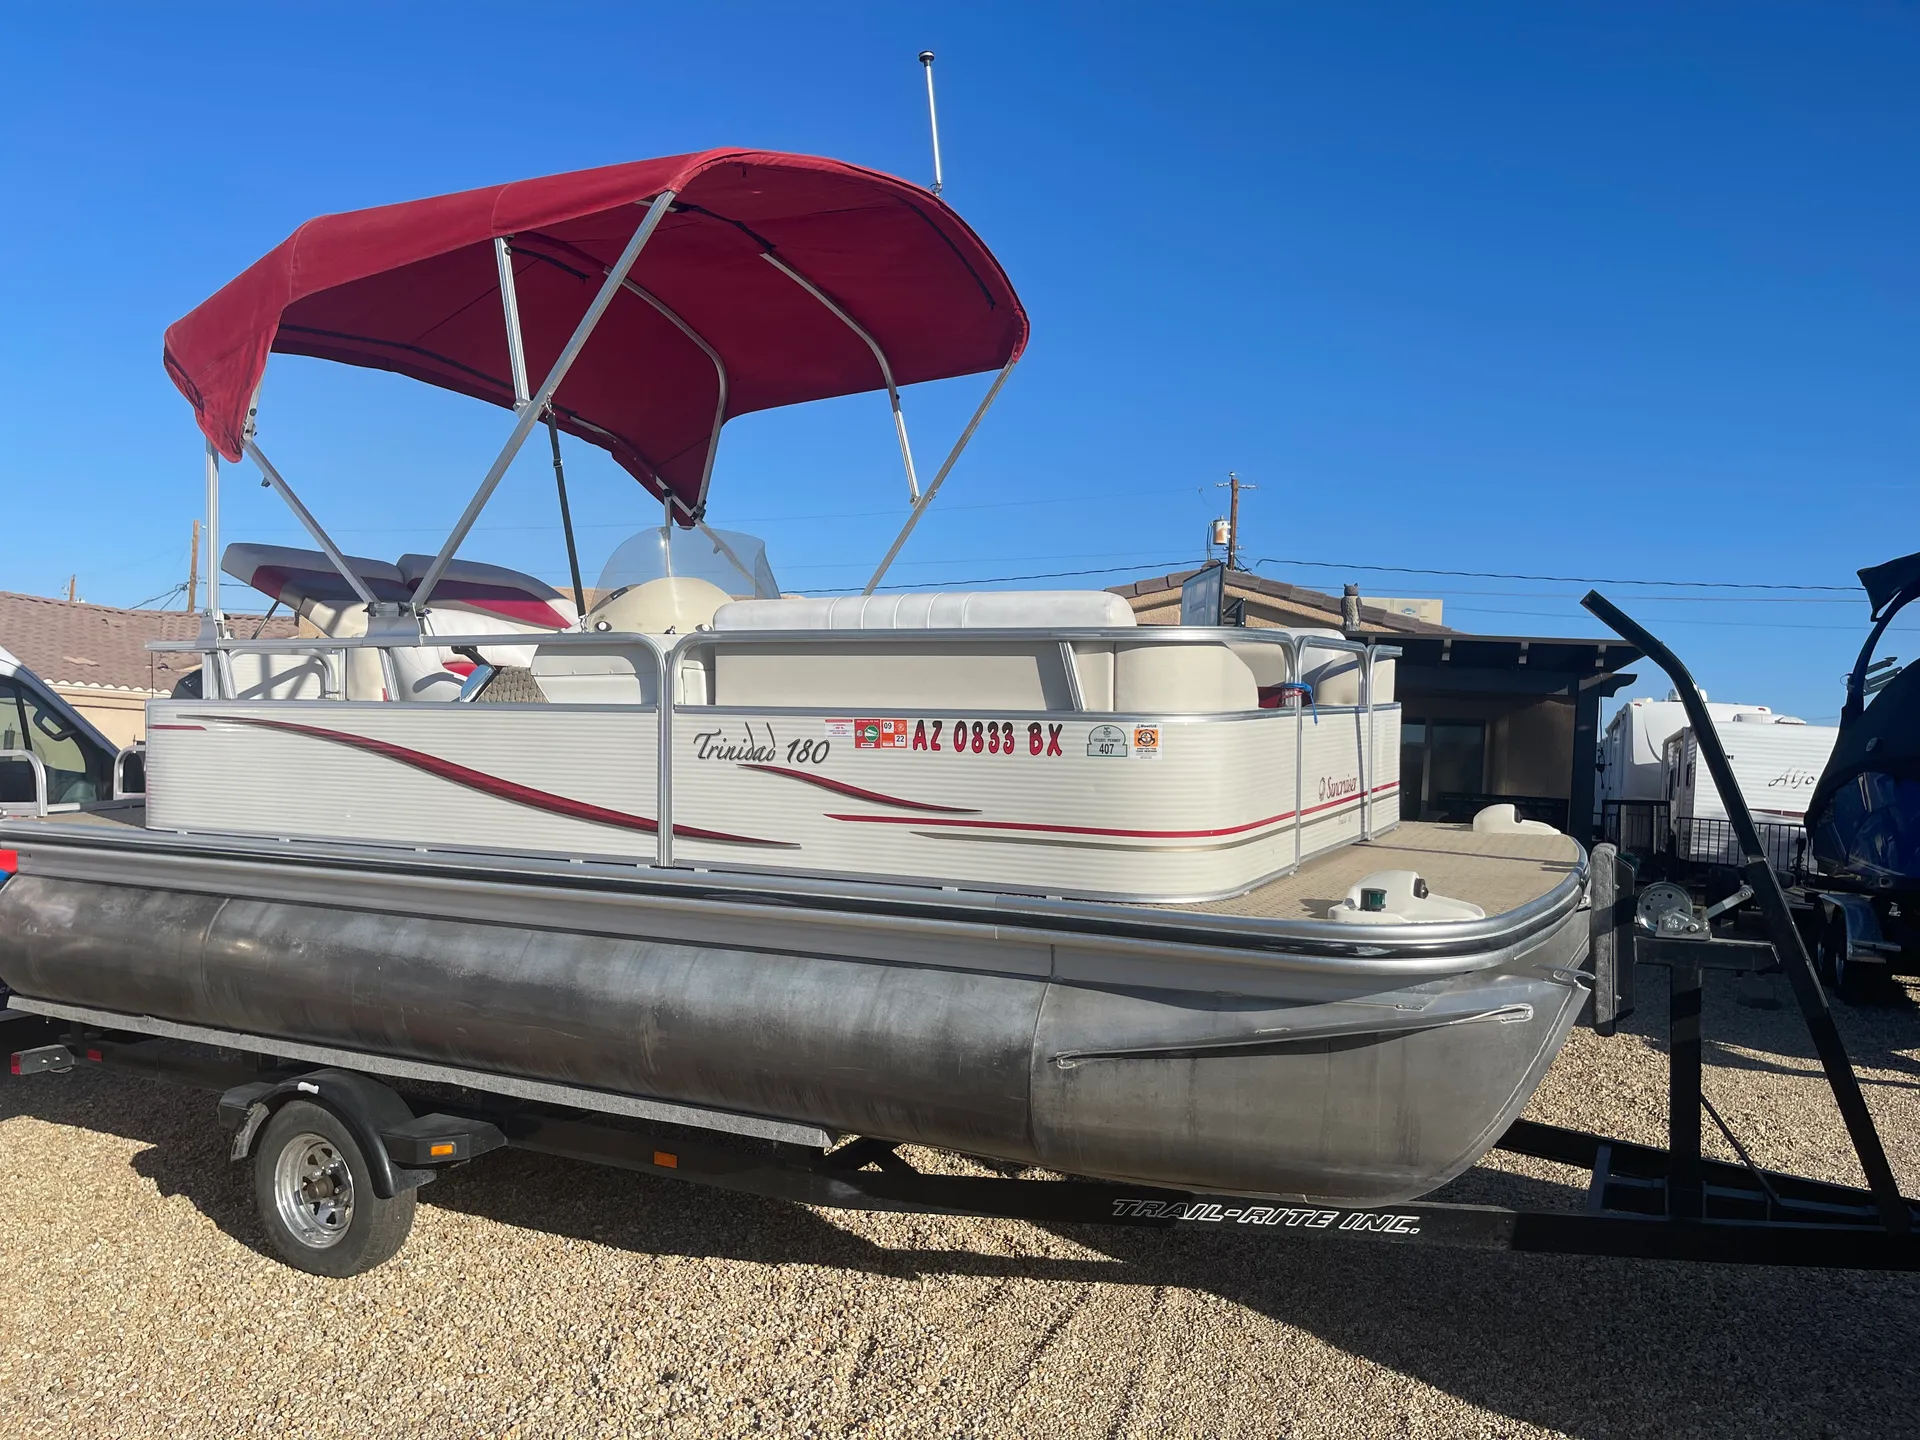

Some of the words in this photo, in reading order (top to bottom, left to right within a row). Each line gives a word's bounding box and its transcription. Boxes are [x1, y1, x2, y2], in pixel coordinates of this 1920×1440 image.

[883, 722, 893, 730] 09
[693, 721, 777, 763] Trinidad
[786, 738, 830, 765] 180
[896, 735, 905, 743] 22
[912, 719, 942, 752] AZ
[953, 720, 1015, 755] 0833
[1027, 721, 1064, 757] BX
[1099, 743, 1115, 754] 407
[1111, 1198, 1339, 1229] TRAIL-RITE
[1338, 1212, 1422, 1234] INC.
